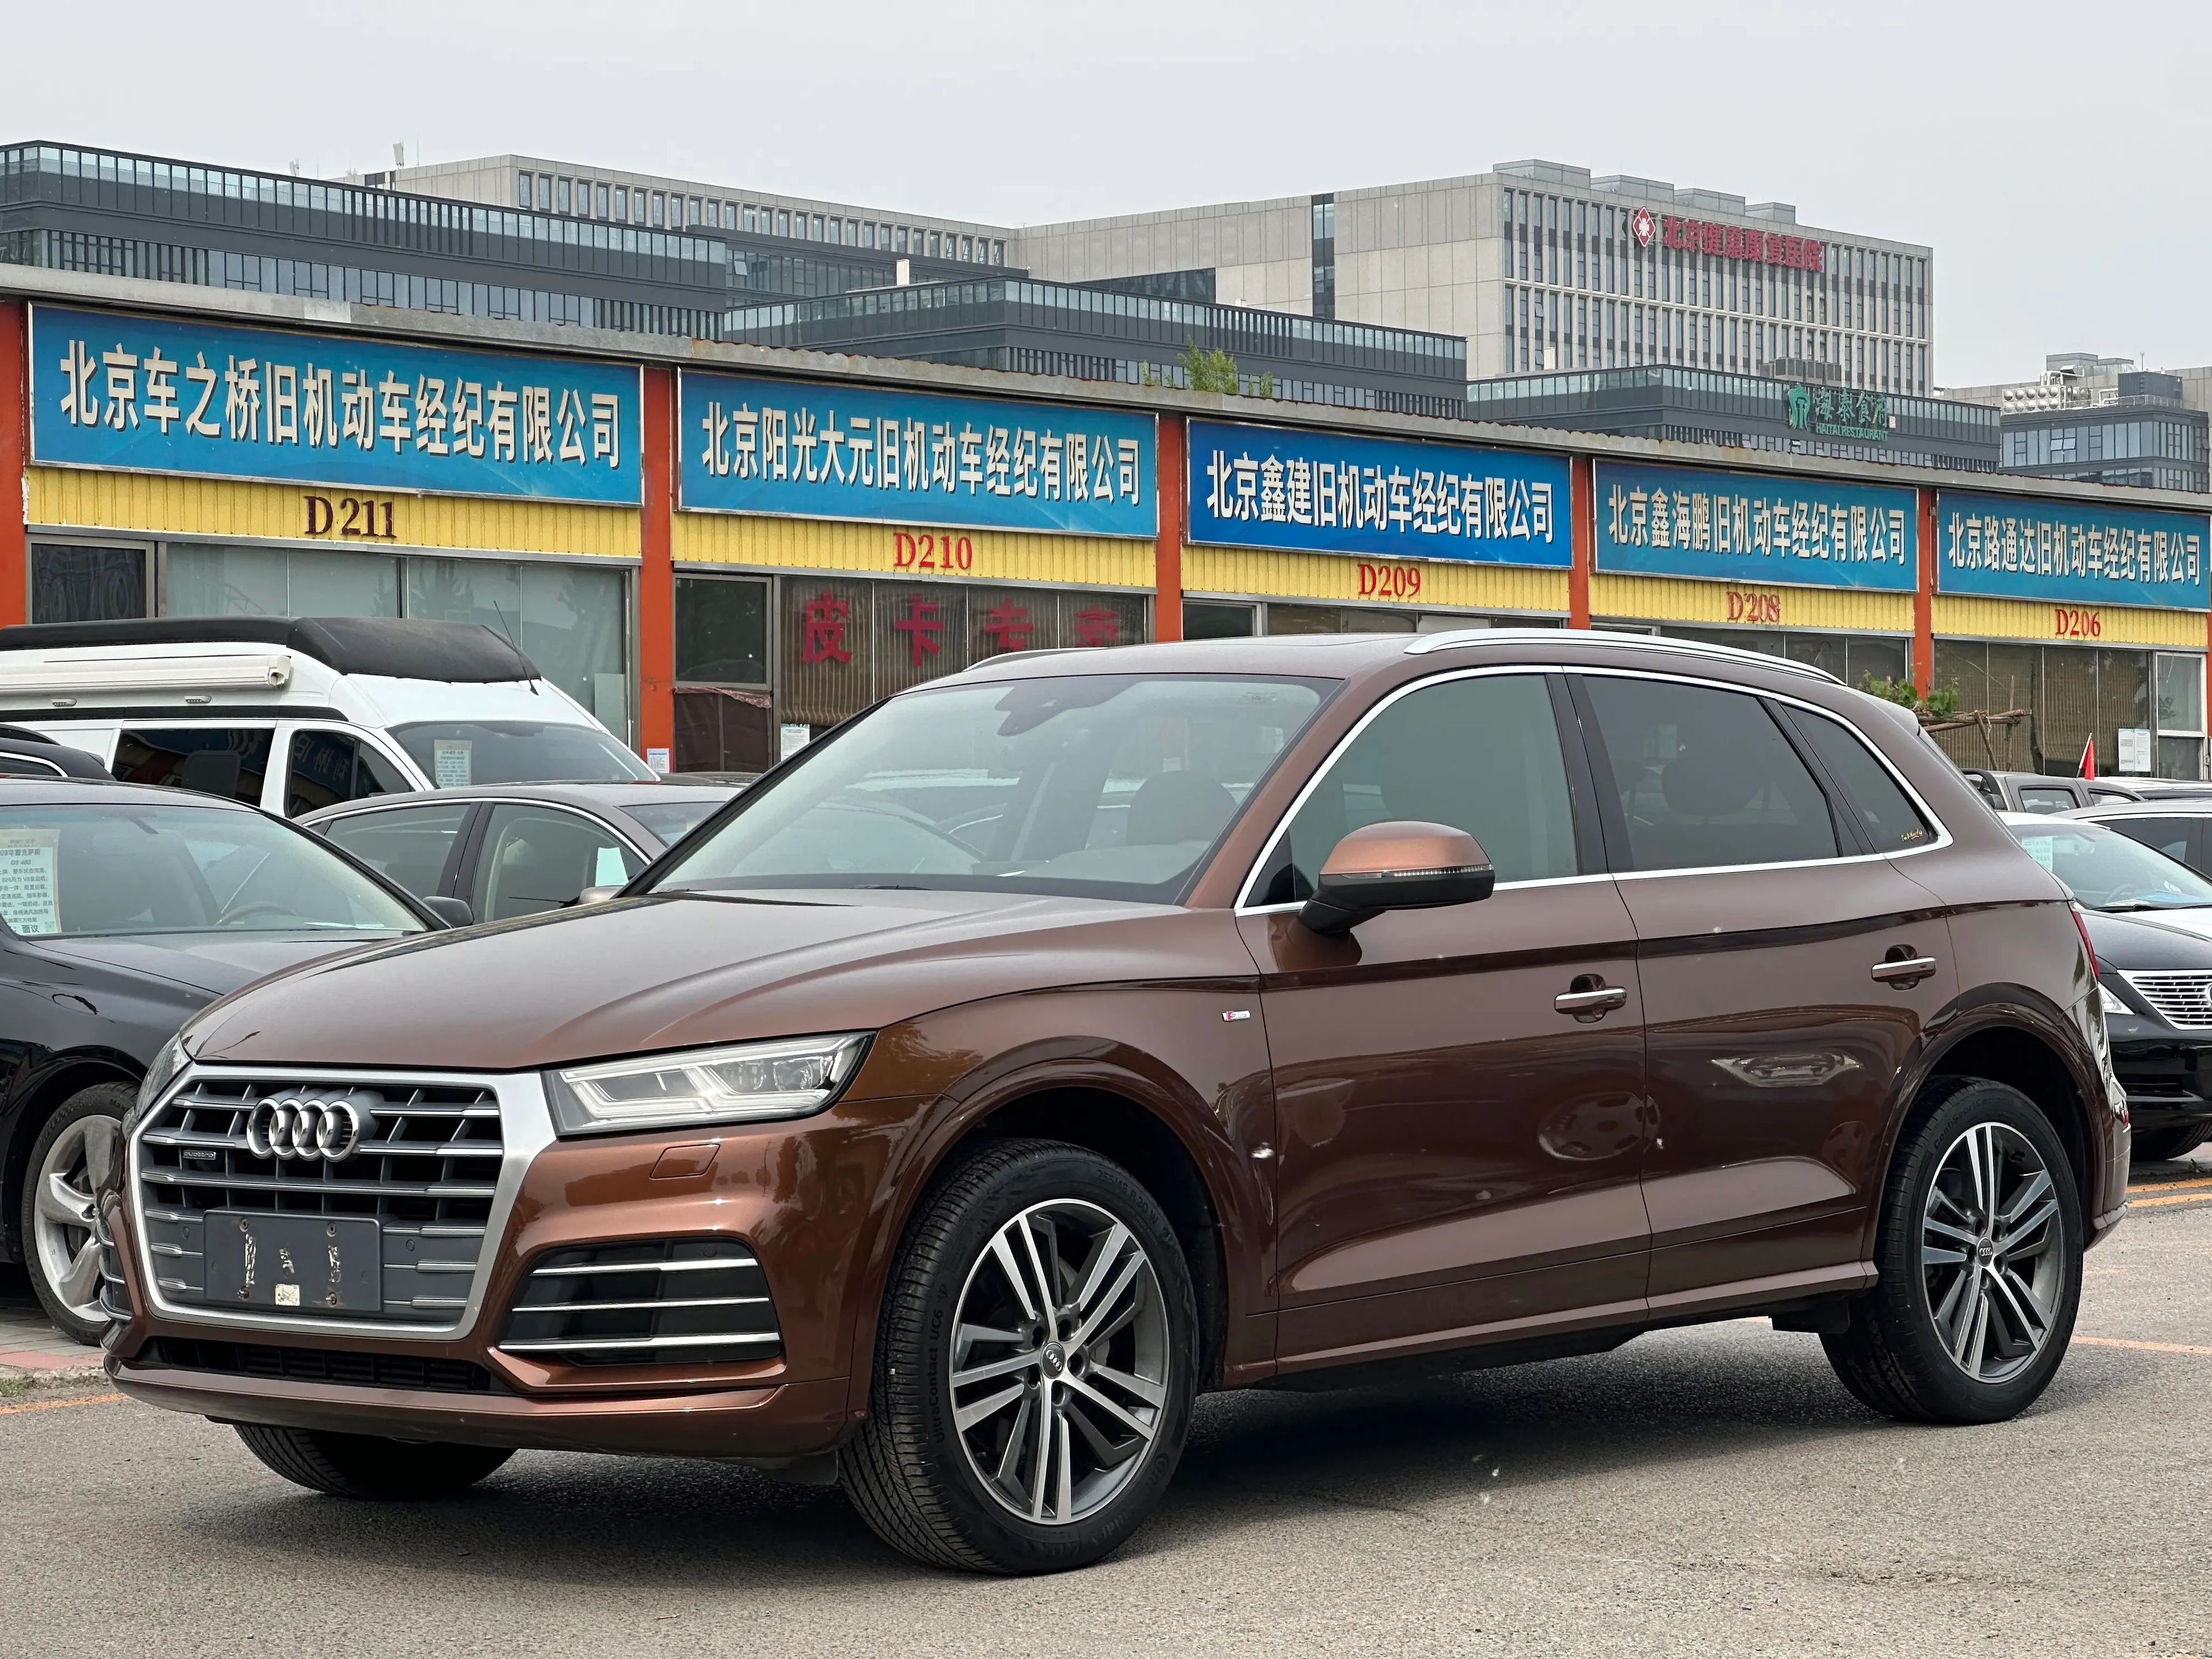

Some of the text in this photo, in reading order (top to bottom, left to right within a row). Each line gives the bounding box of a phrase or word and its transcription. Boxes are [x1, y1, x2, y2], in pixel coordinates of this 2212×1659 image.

[59, 339, 621, 469] 北京车之桥旧机动车经纪有限公司
[702, 402, 1141, 506] 北京阳光大元旧机动车经纪有限公司
[304, 495, 397, 538] D211
[1206, 449, 1554, 543] 北京鑫建旧机动车经纪有限公司
[1608, 484, 1906, 565] 北京鑫海鹏旧机动车经纪有限公司
[895, 532, 972, 570] D210
[1358, 563, 1421, 597] D209
[1948, 512, 2201, 586] 北京路通达旧机动车经纪有限公司
[1726, 591, 1781, 622] D208
[2055, 609, 2101, 637] D206
[928, 1308, 945, 1444] UltraContact UC6
